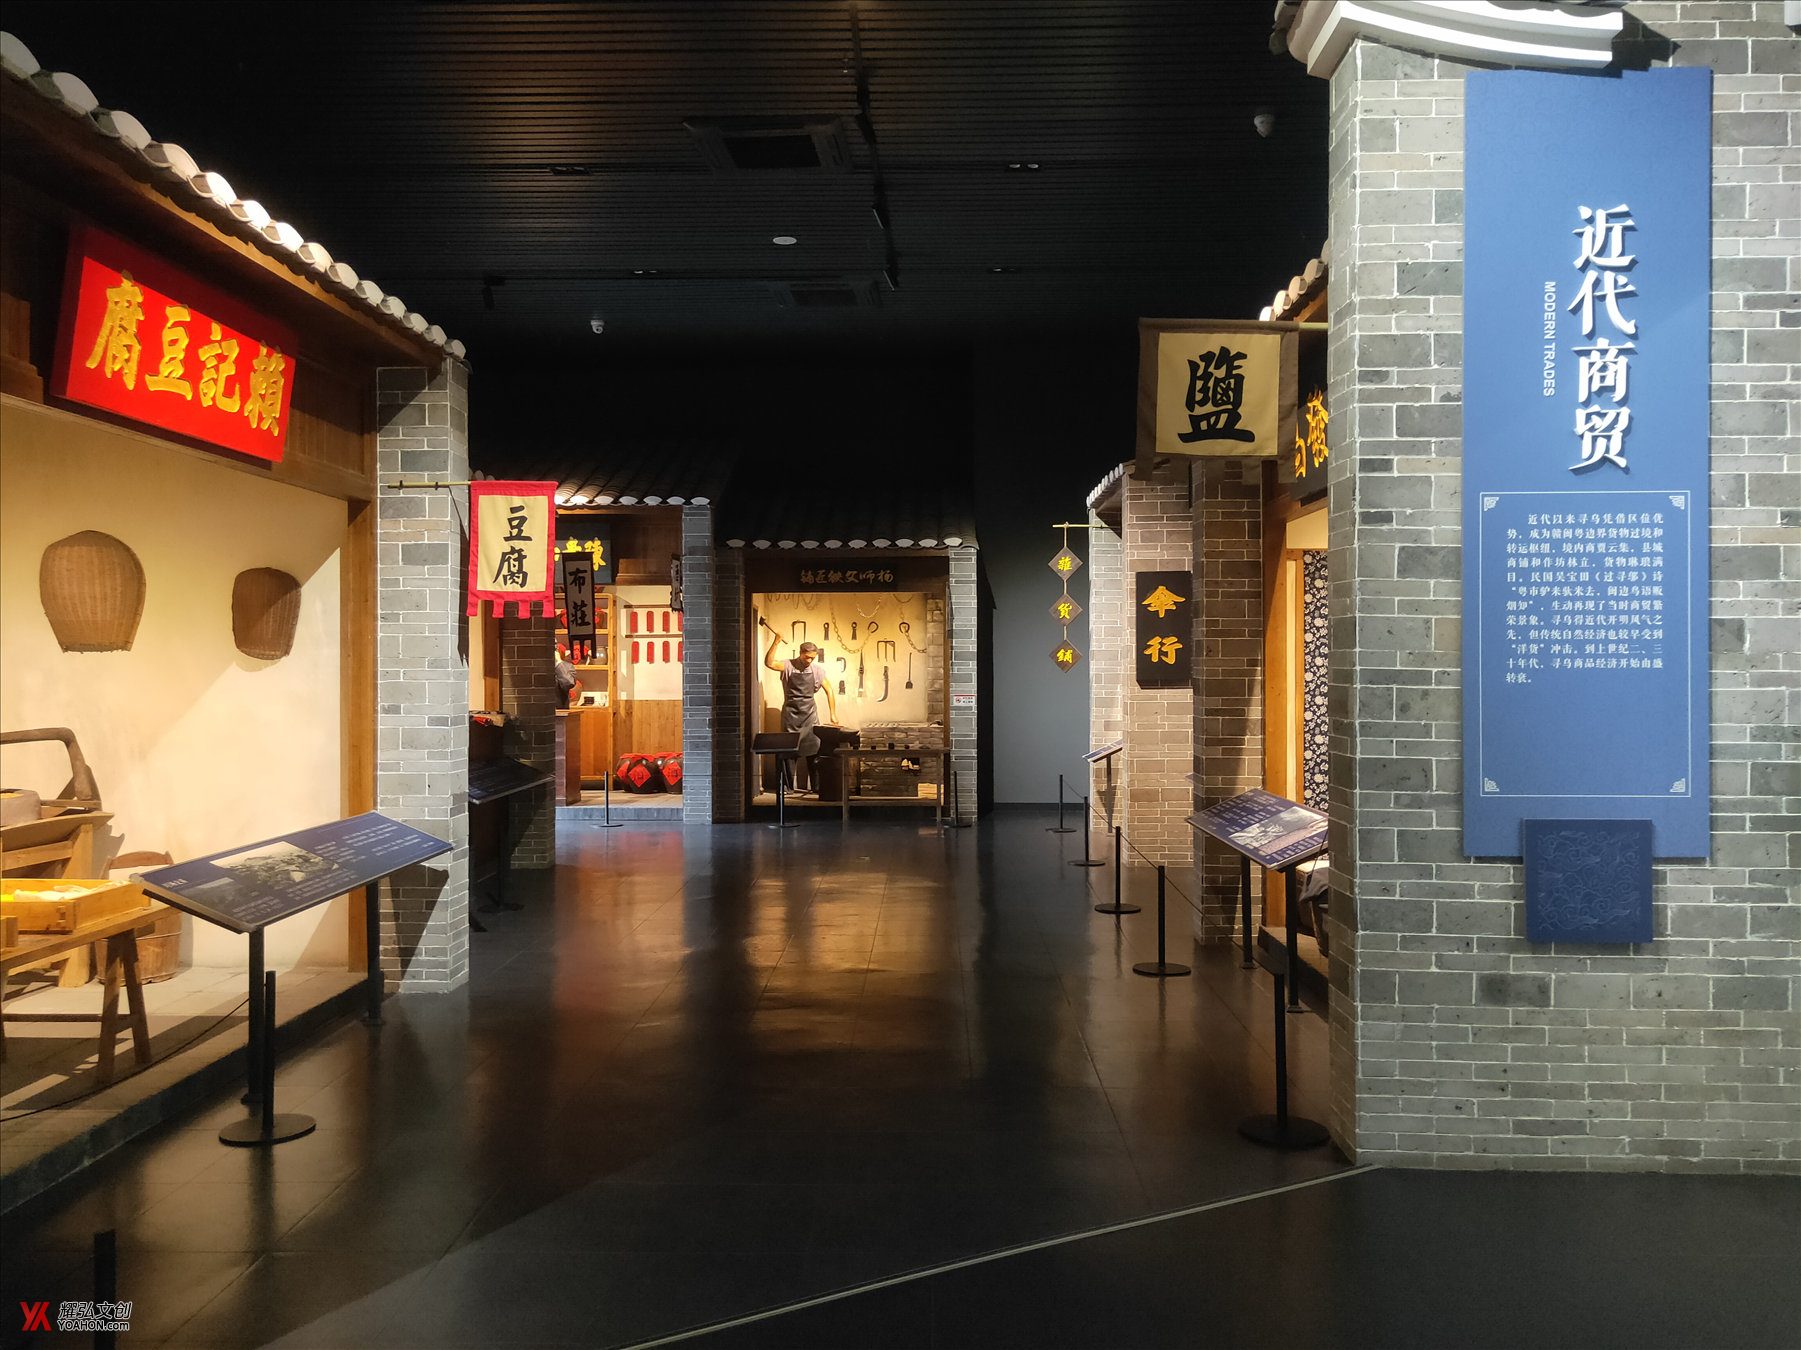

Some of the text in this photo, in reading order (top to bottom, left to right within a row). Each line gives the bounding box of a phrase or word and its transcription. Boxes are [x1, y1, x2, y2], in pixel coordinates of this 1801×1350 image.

[1543, 281, 1557, 397] MODERN TRADES
[1567, 203, 1637, 471] 近代商贸
[492, 505, 533, 588] 豆腐
[1527, 512, 1664, 525] 近代以来寻乌凭借区位优
